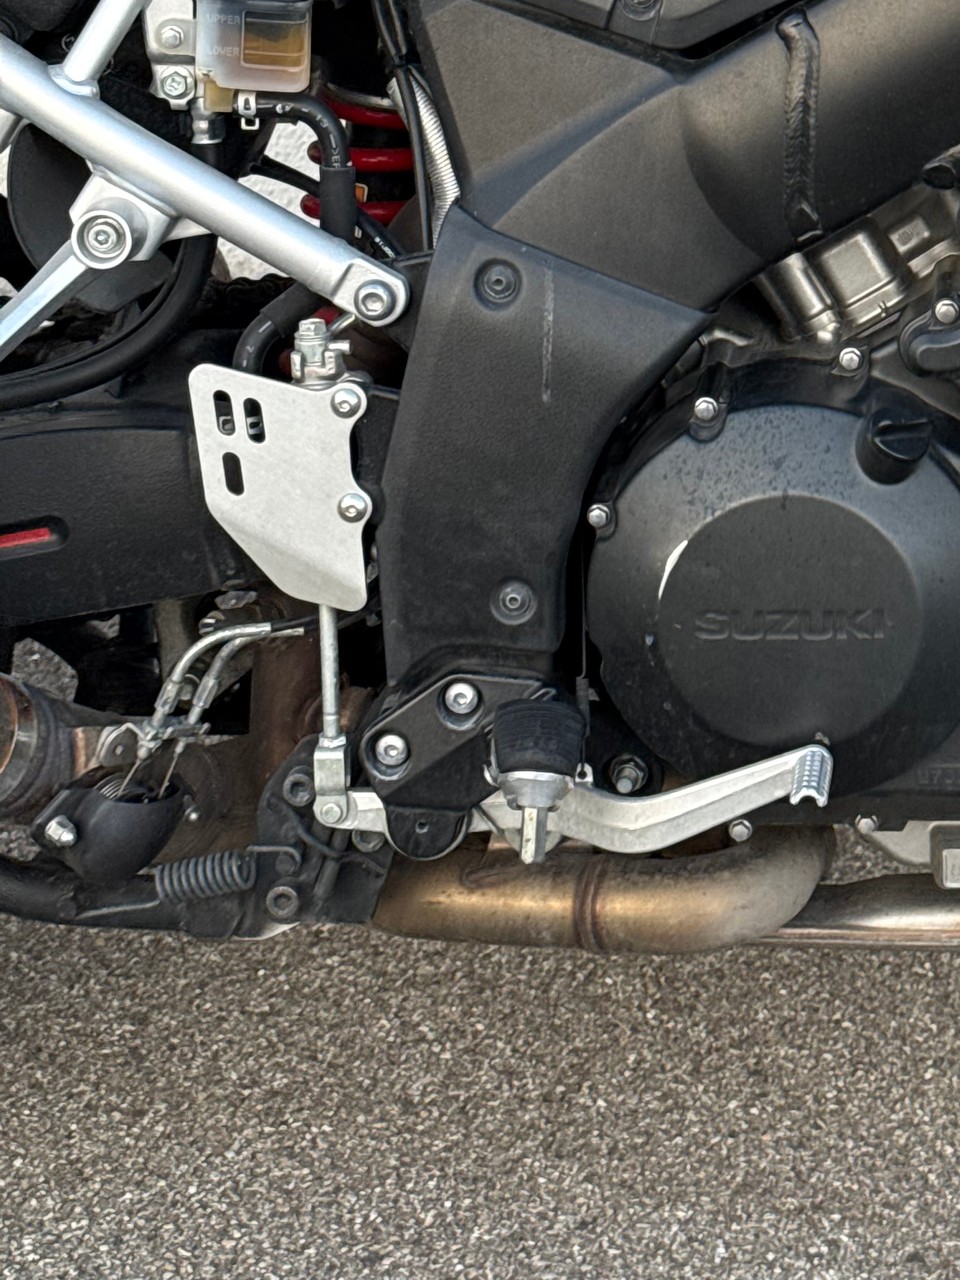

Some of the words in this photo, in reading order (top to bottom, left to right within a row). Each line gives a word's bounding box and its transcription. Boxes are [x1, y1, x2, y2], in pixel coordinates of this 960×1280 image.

[207, 13, 241, 25] UPPER
[206, 46, 240, 57] LOWER
[695, 610, 885, 640] SUZUKI
